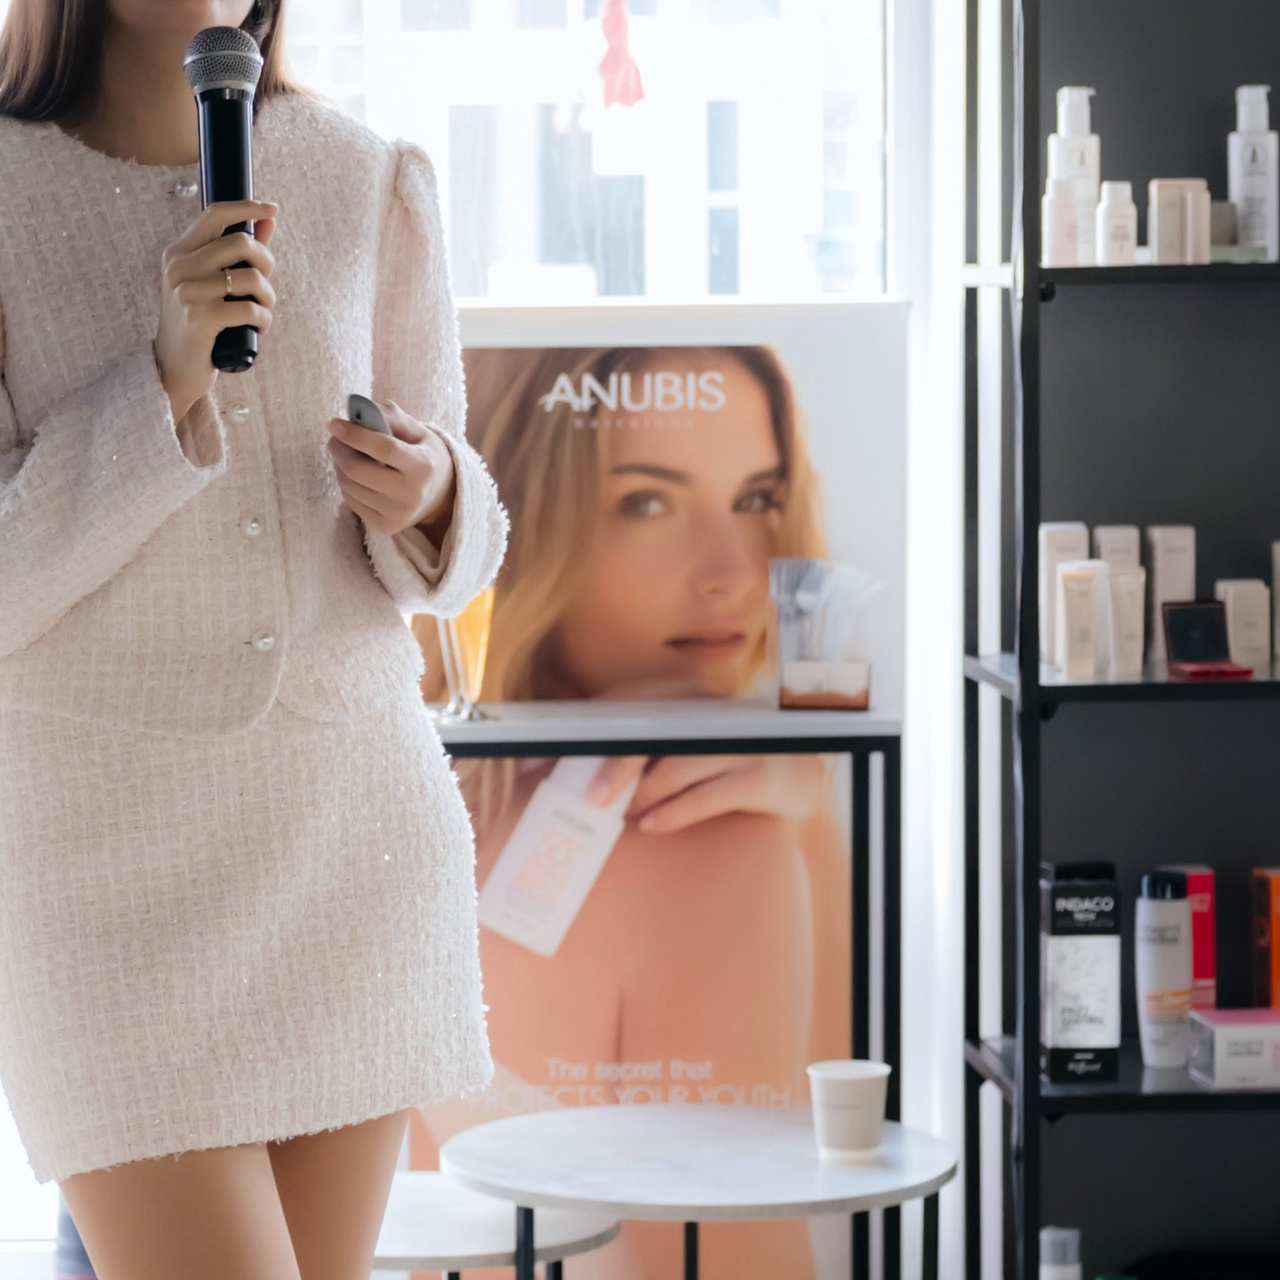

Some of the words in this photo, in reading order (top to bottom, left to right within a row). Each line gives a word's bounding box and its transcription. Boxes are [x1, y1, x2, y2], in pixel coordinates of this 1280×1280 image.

[541, 371, 727, 413] ANUBIS
[545, 1057, 587, 1080] The
[593, 1057, 662, 1081] secret
[668, 1057, 712, 1080] that
